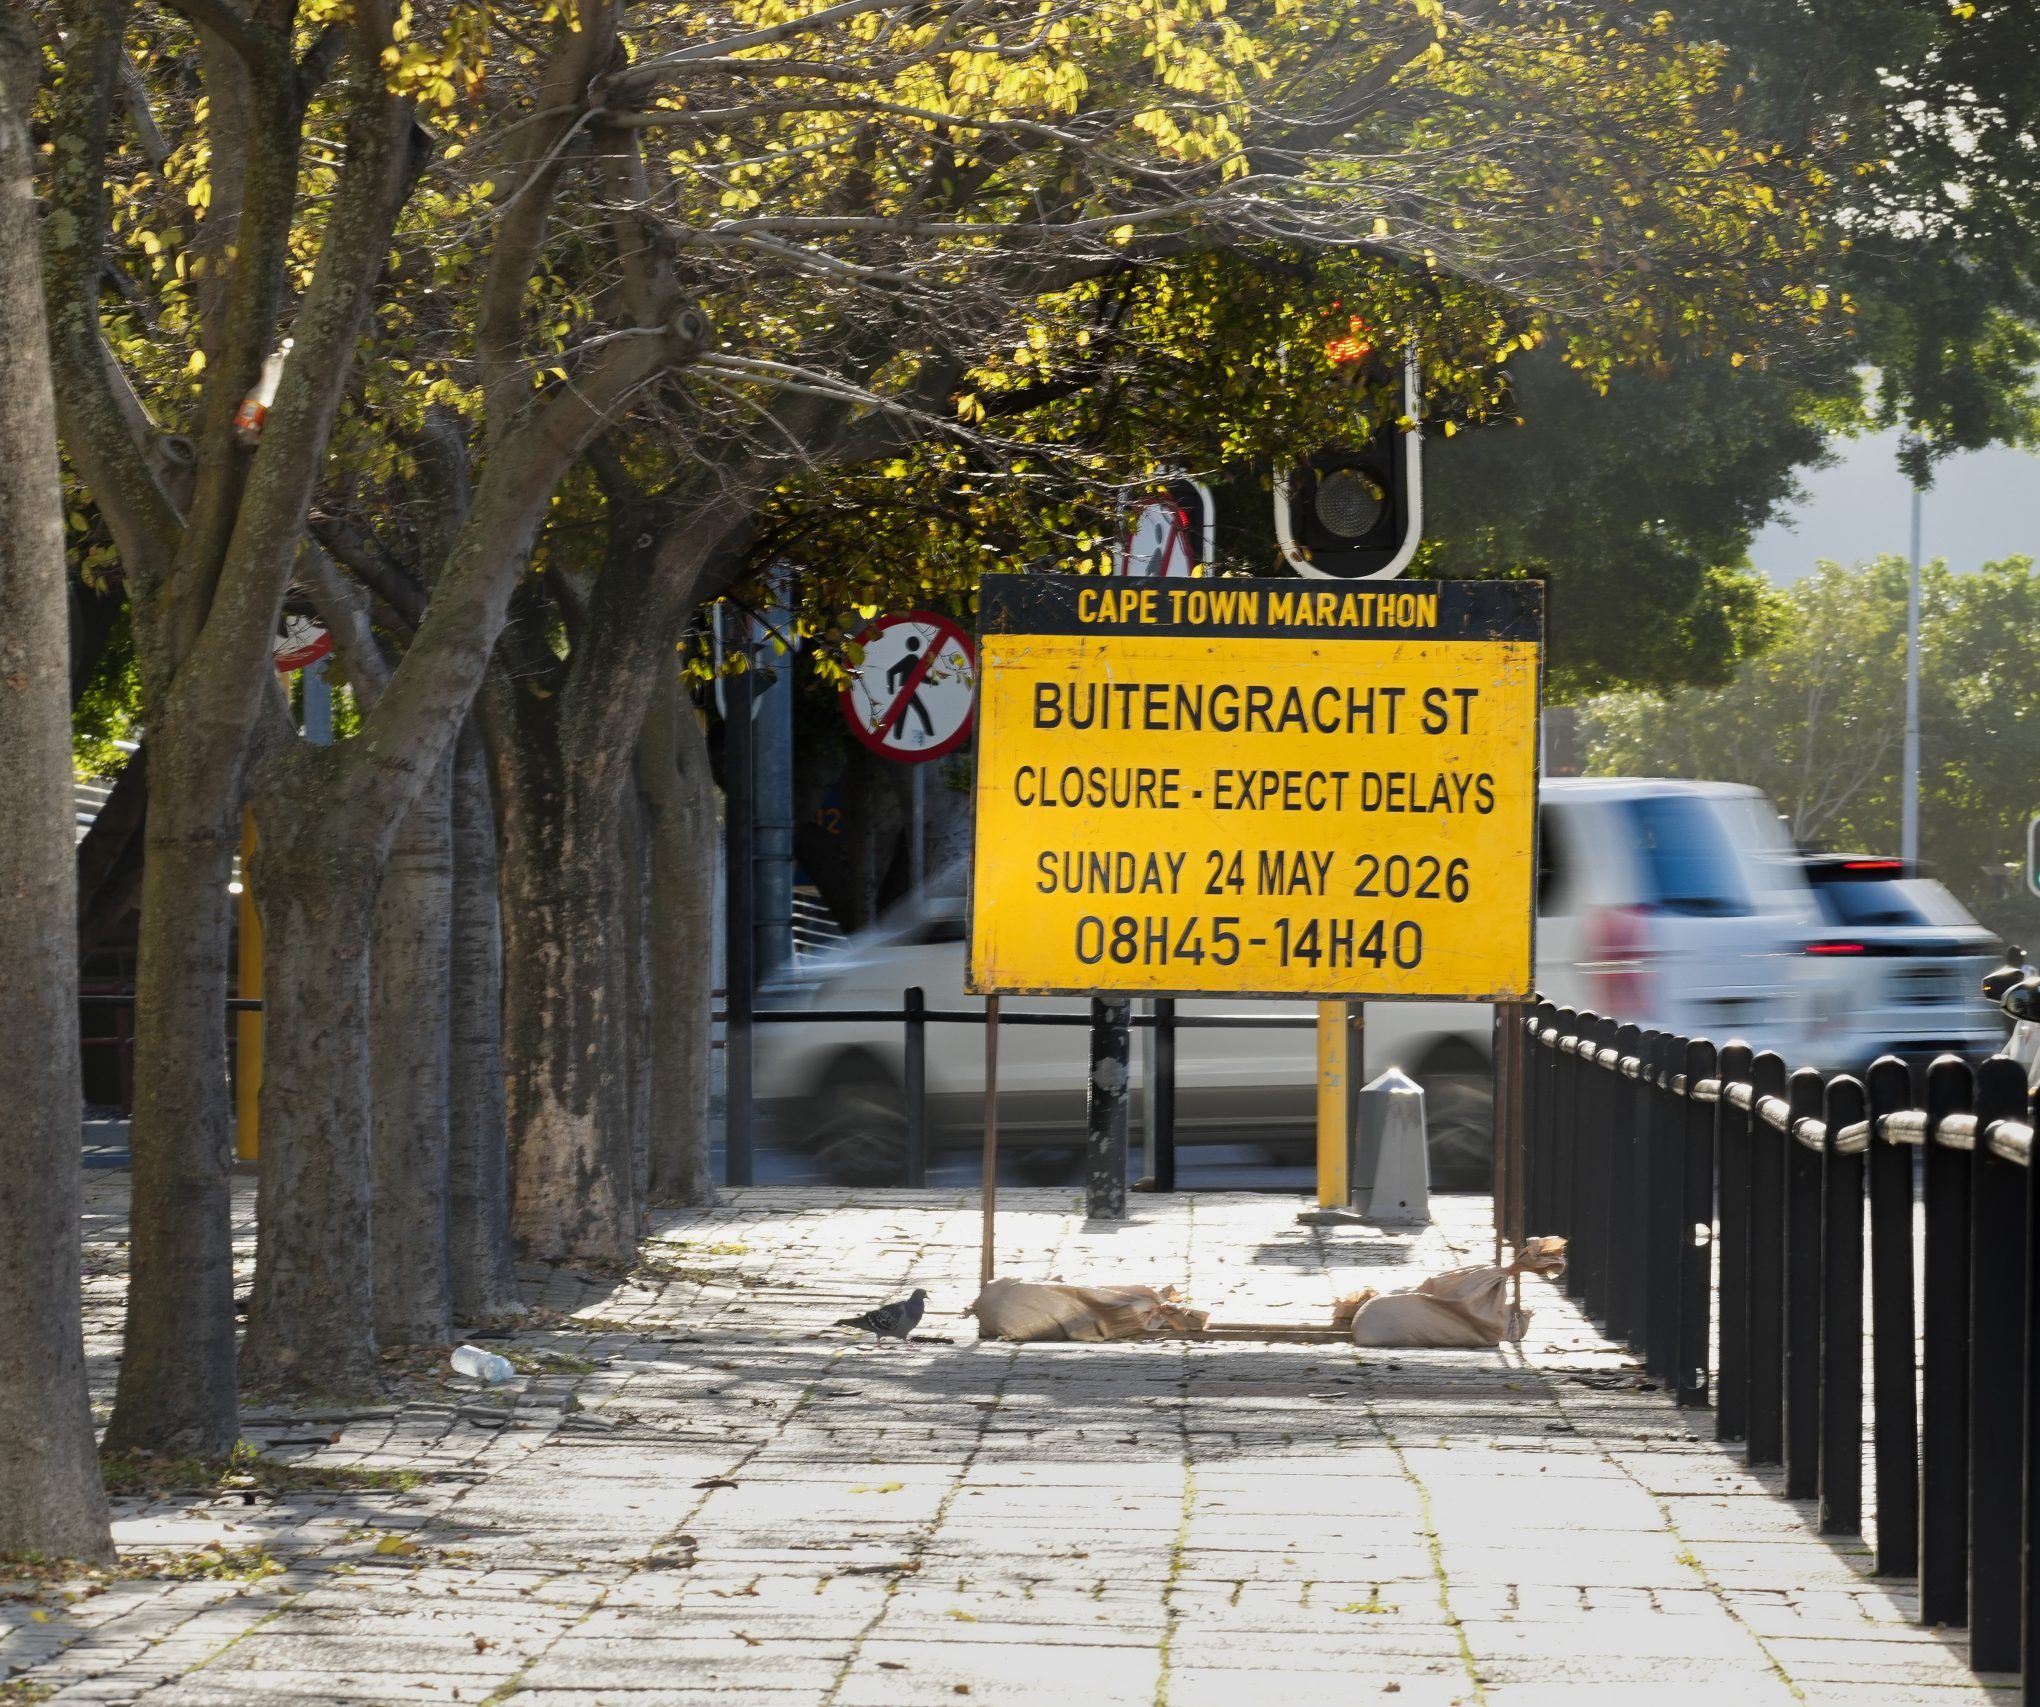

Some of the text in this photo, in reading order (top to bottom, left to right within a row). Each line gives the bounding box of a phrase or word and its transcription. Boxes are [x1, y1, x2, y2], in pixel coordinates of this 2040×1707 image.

[1078, 588, 1437, 628] CAPE TOWN MARATHON
[1033, 683, 1479, 735] BUITENGRACHT ST
[1014, 765, 1180, 808] CLOSURE
[1213, 770, 1349, 811] EXPECT
[1362, 772, 1495, 815] DELAYS
[1036, 850, 1470, 903] SUNDAY 24 MAY 2026
